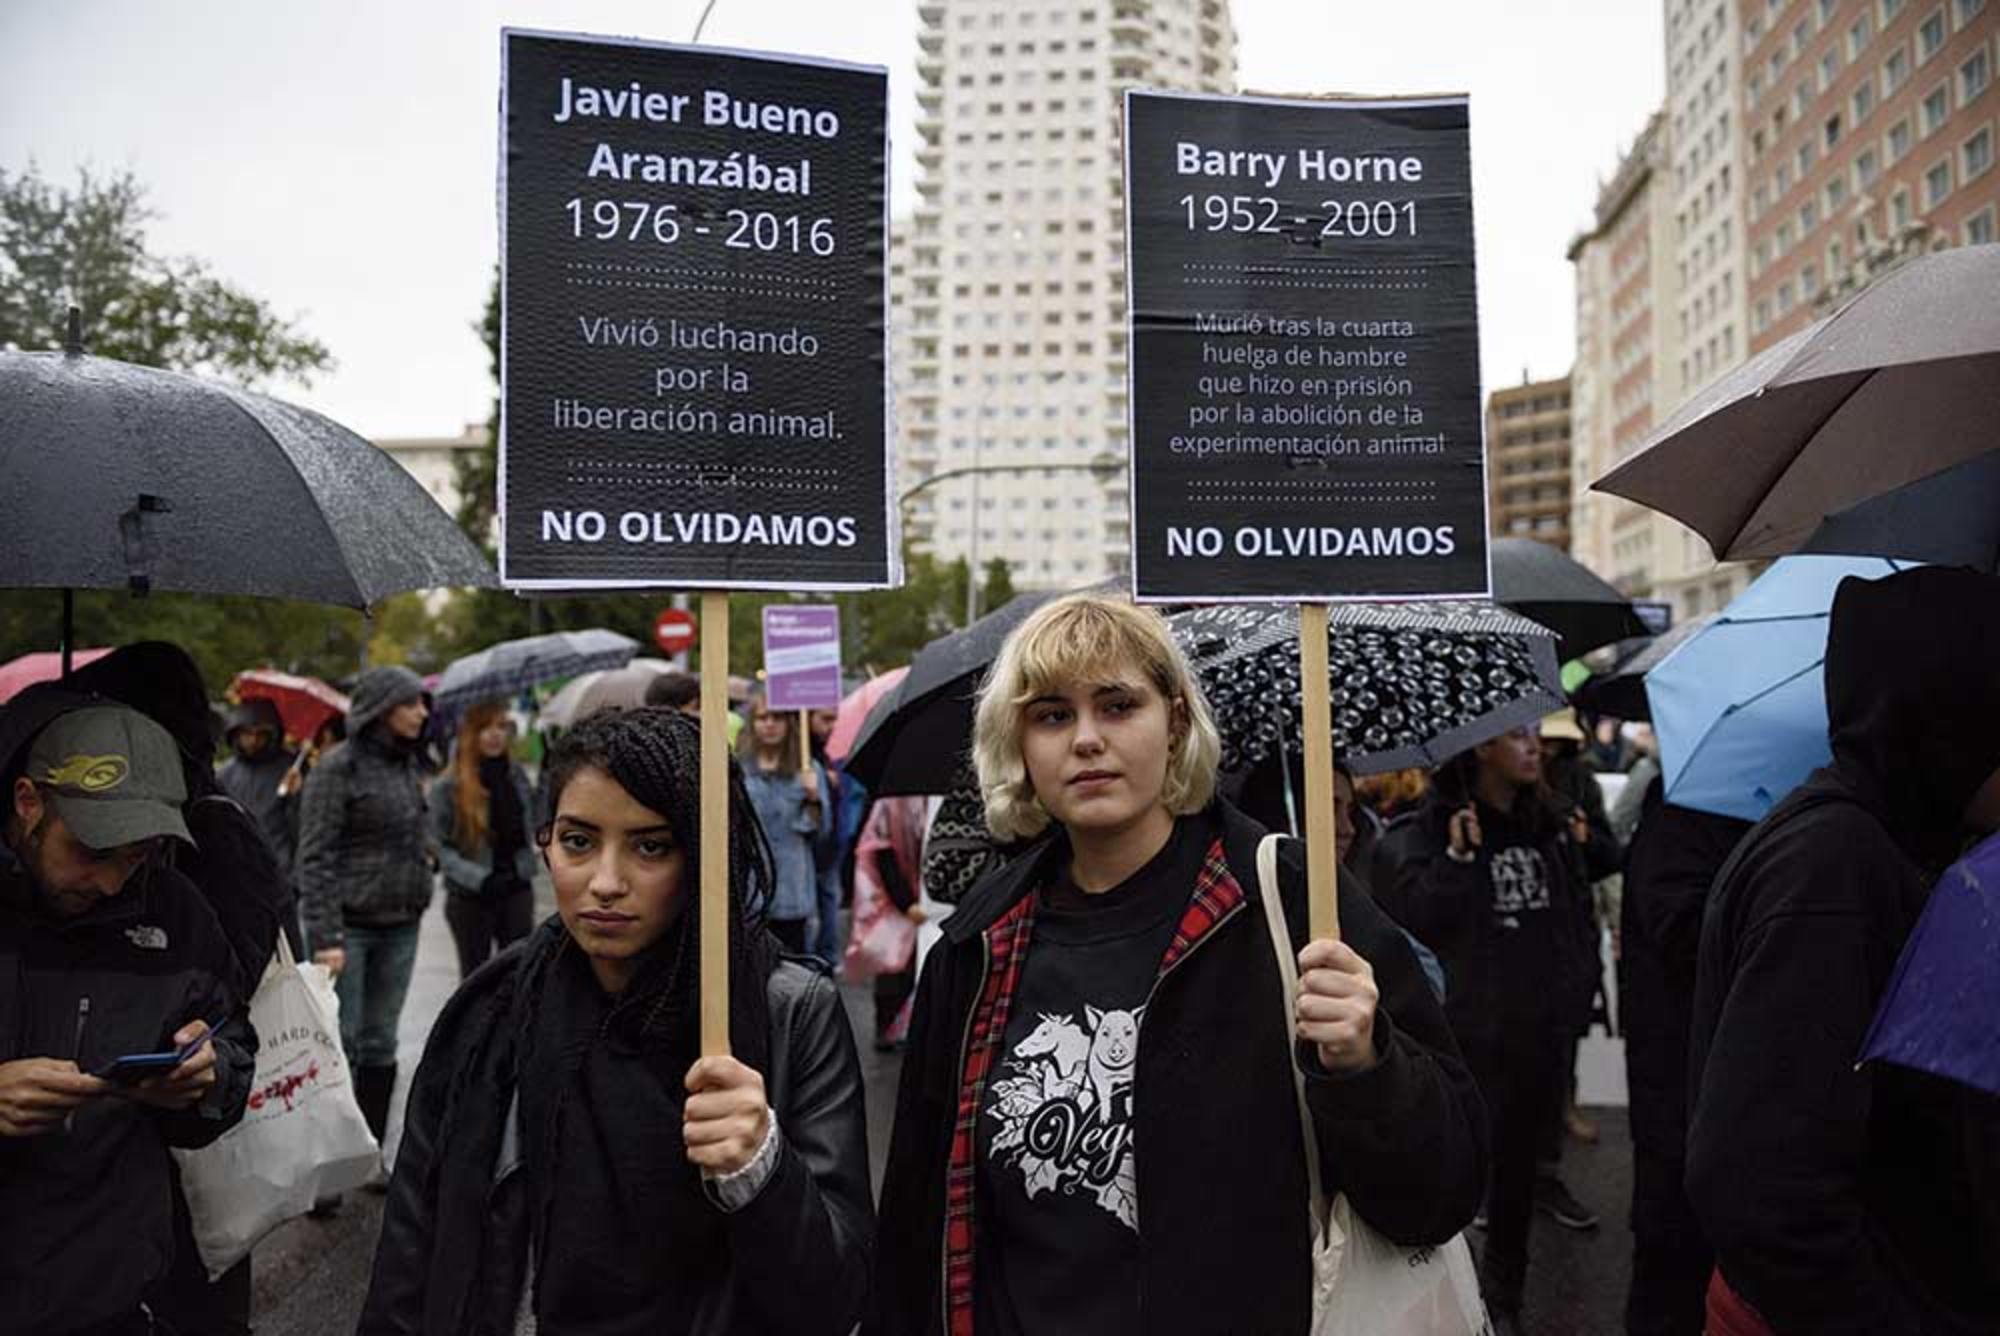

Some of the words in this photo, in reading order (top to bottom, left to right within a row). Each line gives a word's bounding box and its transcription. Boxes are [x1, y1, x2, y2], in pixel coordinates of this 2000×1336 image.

[554, 77, 689, 124] Javier
[703, 90, 839, 138] Bueno
[588, 143, 811, 195] Aranzábal
[1177, 142, 1286, 187] Barry
[1301, 149, 1422, 182] Horne
[565, 198, 679, 243] 1976
[725, 210, 835, 256] 2016
[1180, 195, 1280, 232] 1952
[1321, 201, 1416, 236] 2001
[580, 317, 659, 347] Vivió
[671, 320, 819, 356] luchando
[1196, 312, 1262, 334] Murió
[1269, 316, 1311, 335] tras
[1318, 318, 1335, 336] la
[1342, 321, 1413, 337] cuarta
[1203, 343, 1278, 369] huelga
[1284, 346, 1312, 365] de
[1319, 346, 1407, 366] hambre
[656, 367, 710, 396] por
[723, 364, 749, 392] la
[1199, 378, 1243, 398] que
[1250, 374, 1294, 395] hizo
[1301, 380, 1328, 395] en
[1336, 375, 1412, 400] prisión
[554, 400, 717, 433] liberación
[728, 409, 843, 440] animal.
[1189, 407, 1229, 428] por
[1236, 403, 1254, 422] la
[1261, 404, 1361, 425] abolición
[1369, 404, 1397, 424] de
[1405, 404, 1423, 424] la
[1169, 433, 1361, 458] experimentación
[1367, 433, 1445, 454] animal
[542, 510, 605, 541] NO
[620, 512, 856, 547] OLVIDAMOS
[1167, 527, 1223, 557] NO
[1235, 526, 1455, 557] OLVIDAMOS
